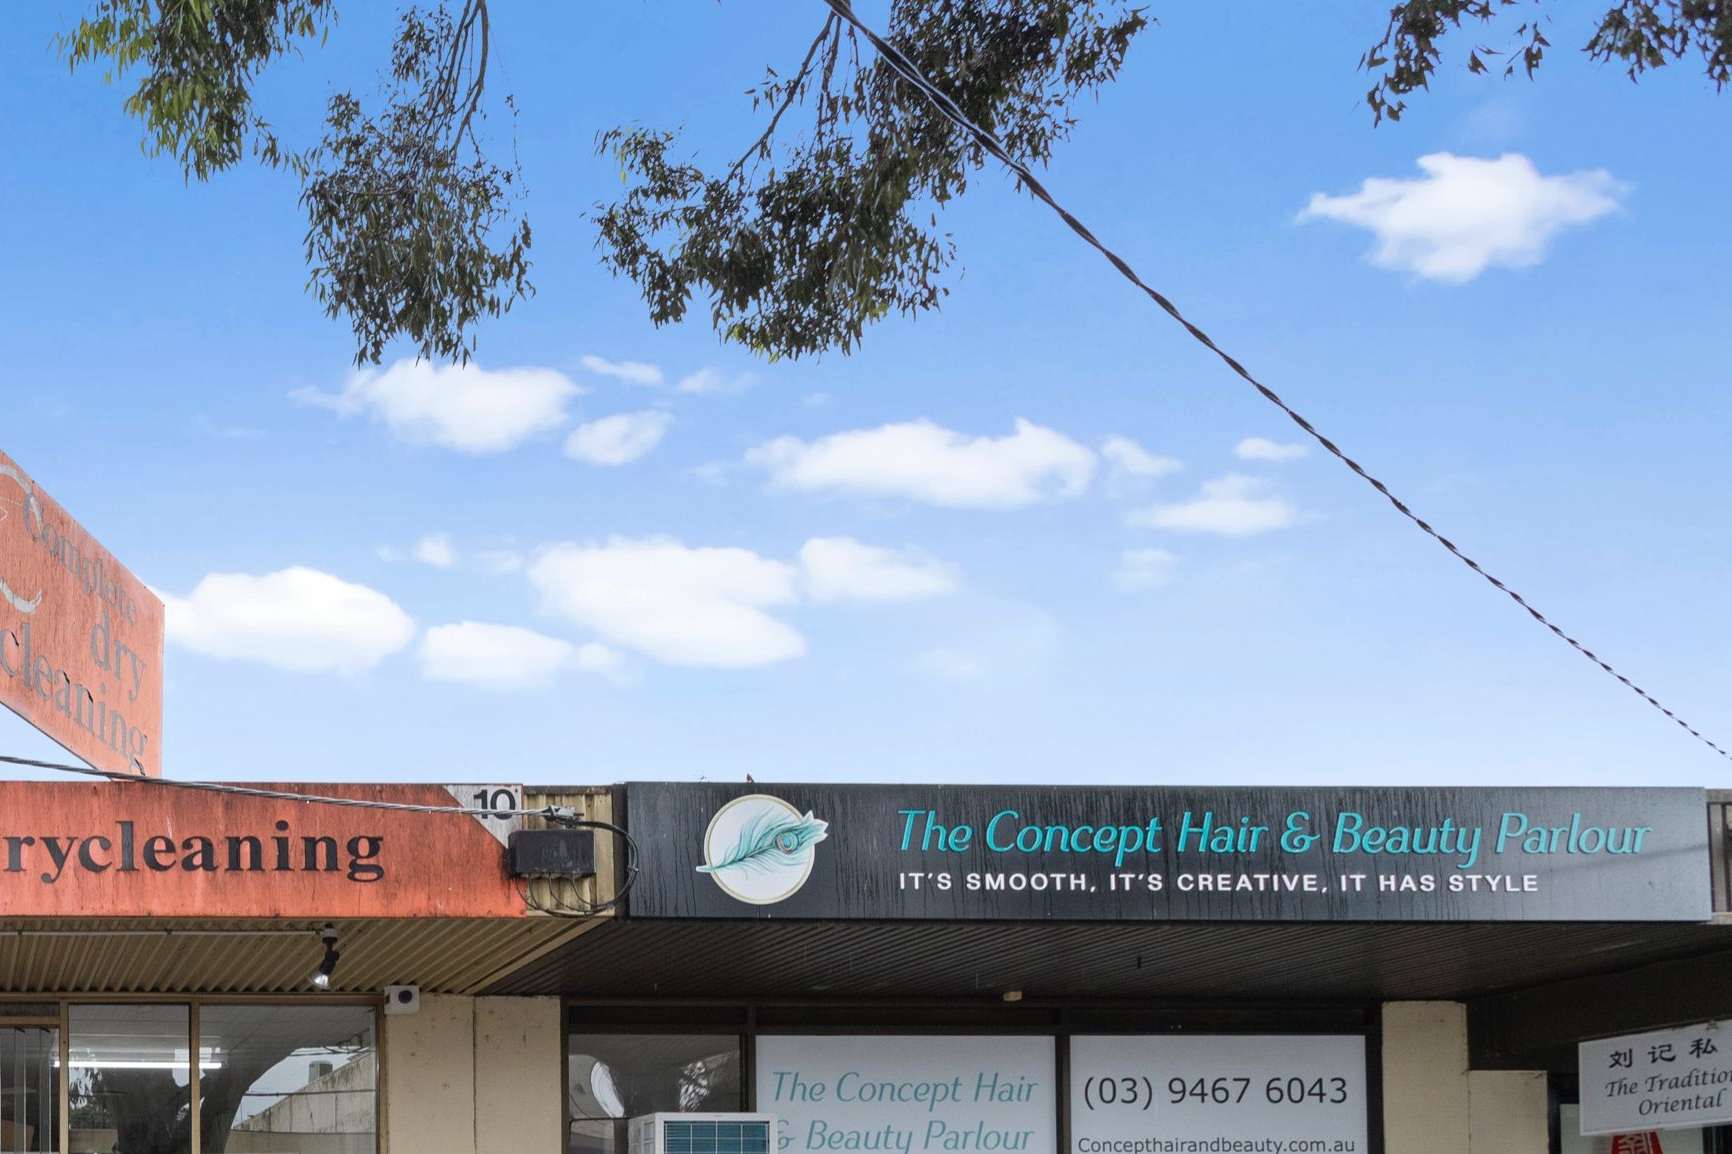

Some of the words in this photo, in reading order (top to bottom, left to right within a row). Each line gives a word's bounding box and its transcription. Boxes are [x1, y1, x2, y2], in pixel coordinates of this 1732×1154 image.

[23, 492, 136, 625] Complete
[91, 610, 147, 701] dry
[473, 789, 517, 820] 10
[898, 810, 972, 853] The
[986, 810, 1161, 867] Concept
[1177, 811, 1268, 854] Hair
[1280, 811, 1320, 854] &
[1332, 812, 1482, 869] Beauty
[1495, 812, 1653, 855] Parlour
[900, 873, 952, 891] IT'S
[967, 873, 1097, 894] SMOOTH,
[1110, 873, 1163, 891] IT'S
[1177, 873, 1328, 894] CREATIVE,
[1340, 874, 1365, 892] IT
[1379, 874, 1435, 892] HAS
[1449, 874, 1538, 892] STYLE
[771, 1071, 826, 1103] The
[835, 1071, 963, 1113] Concept
[974, 1072, 1039, 1103] Hair
[1084, 1075, 1154, 1110] (03)
[1168, 1077, 1249, 1104] 9467
[1265, 1077, 1349, 1104] 6043
[1605, 1078, 1637, 1098] The
[1639, 1088, 1724, 1115] Oriental
[923, 1120, 1035, 1151] Parlour
